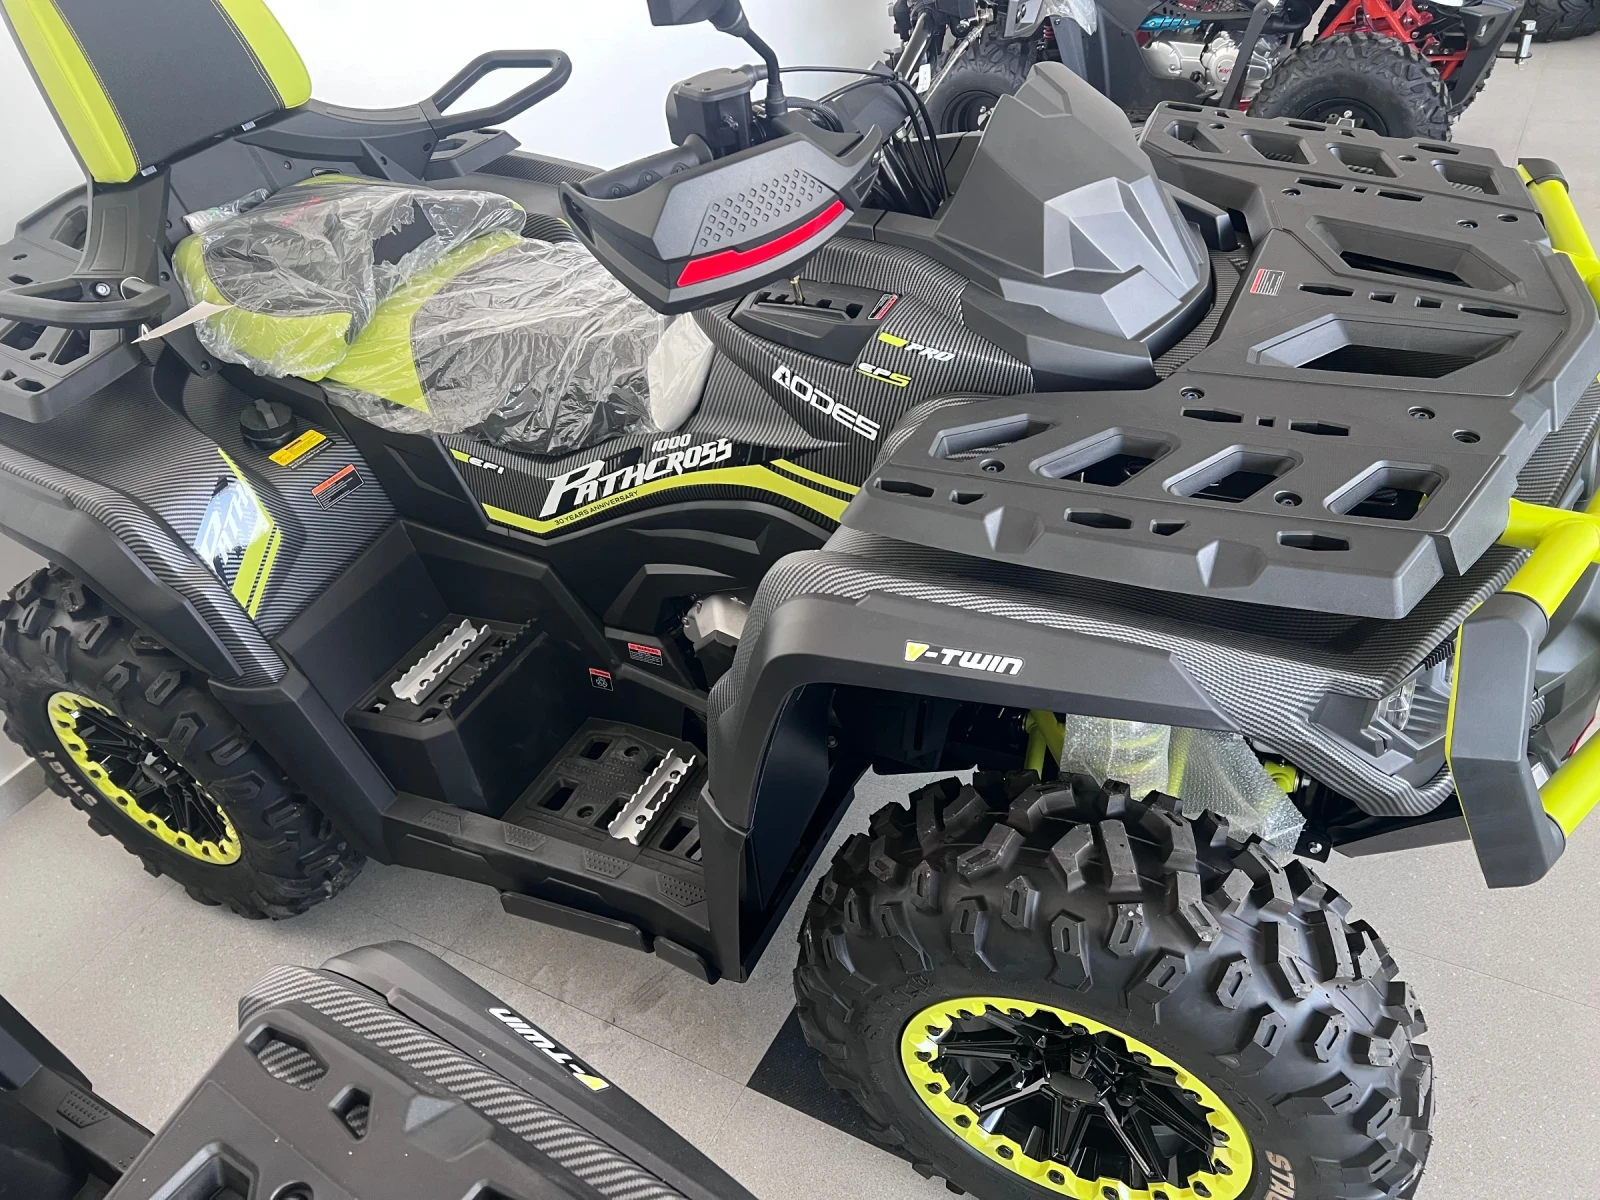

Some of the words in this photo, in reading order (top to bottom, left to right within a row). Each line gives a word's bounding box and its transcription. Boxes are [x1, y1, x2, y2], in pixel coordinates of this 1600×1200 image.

[904, 342, 956, 362] PRO
[857, 362, 912, 387] EPS
[771, 364, 881, 441] AODES
[651, 433, 691, 453] 1000
[467, 456, 504, 474] EFI
[538, 438, 733, 518] PATHCROSS
[554, 517, 565, 526] 30
[565, 509, 589, 523] YEARS
[589, 490, 639, 514] ANNIVERSARY
[904, 641, 1024, 676] V-TWIN
[48, 761, 98, 807] STAG
